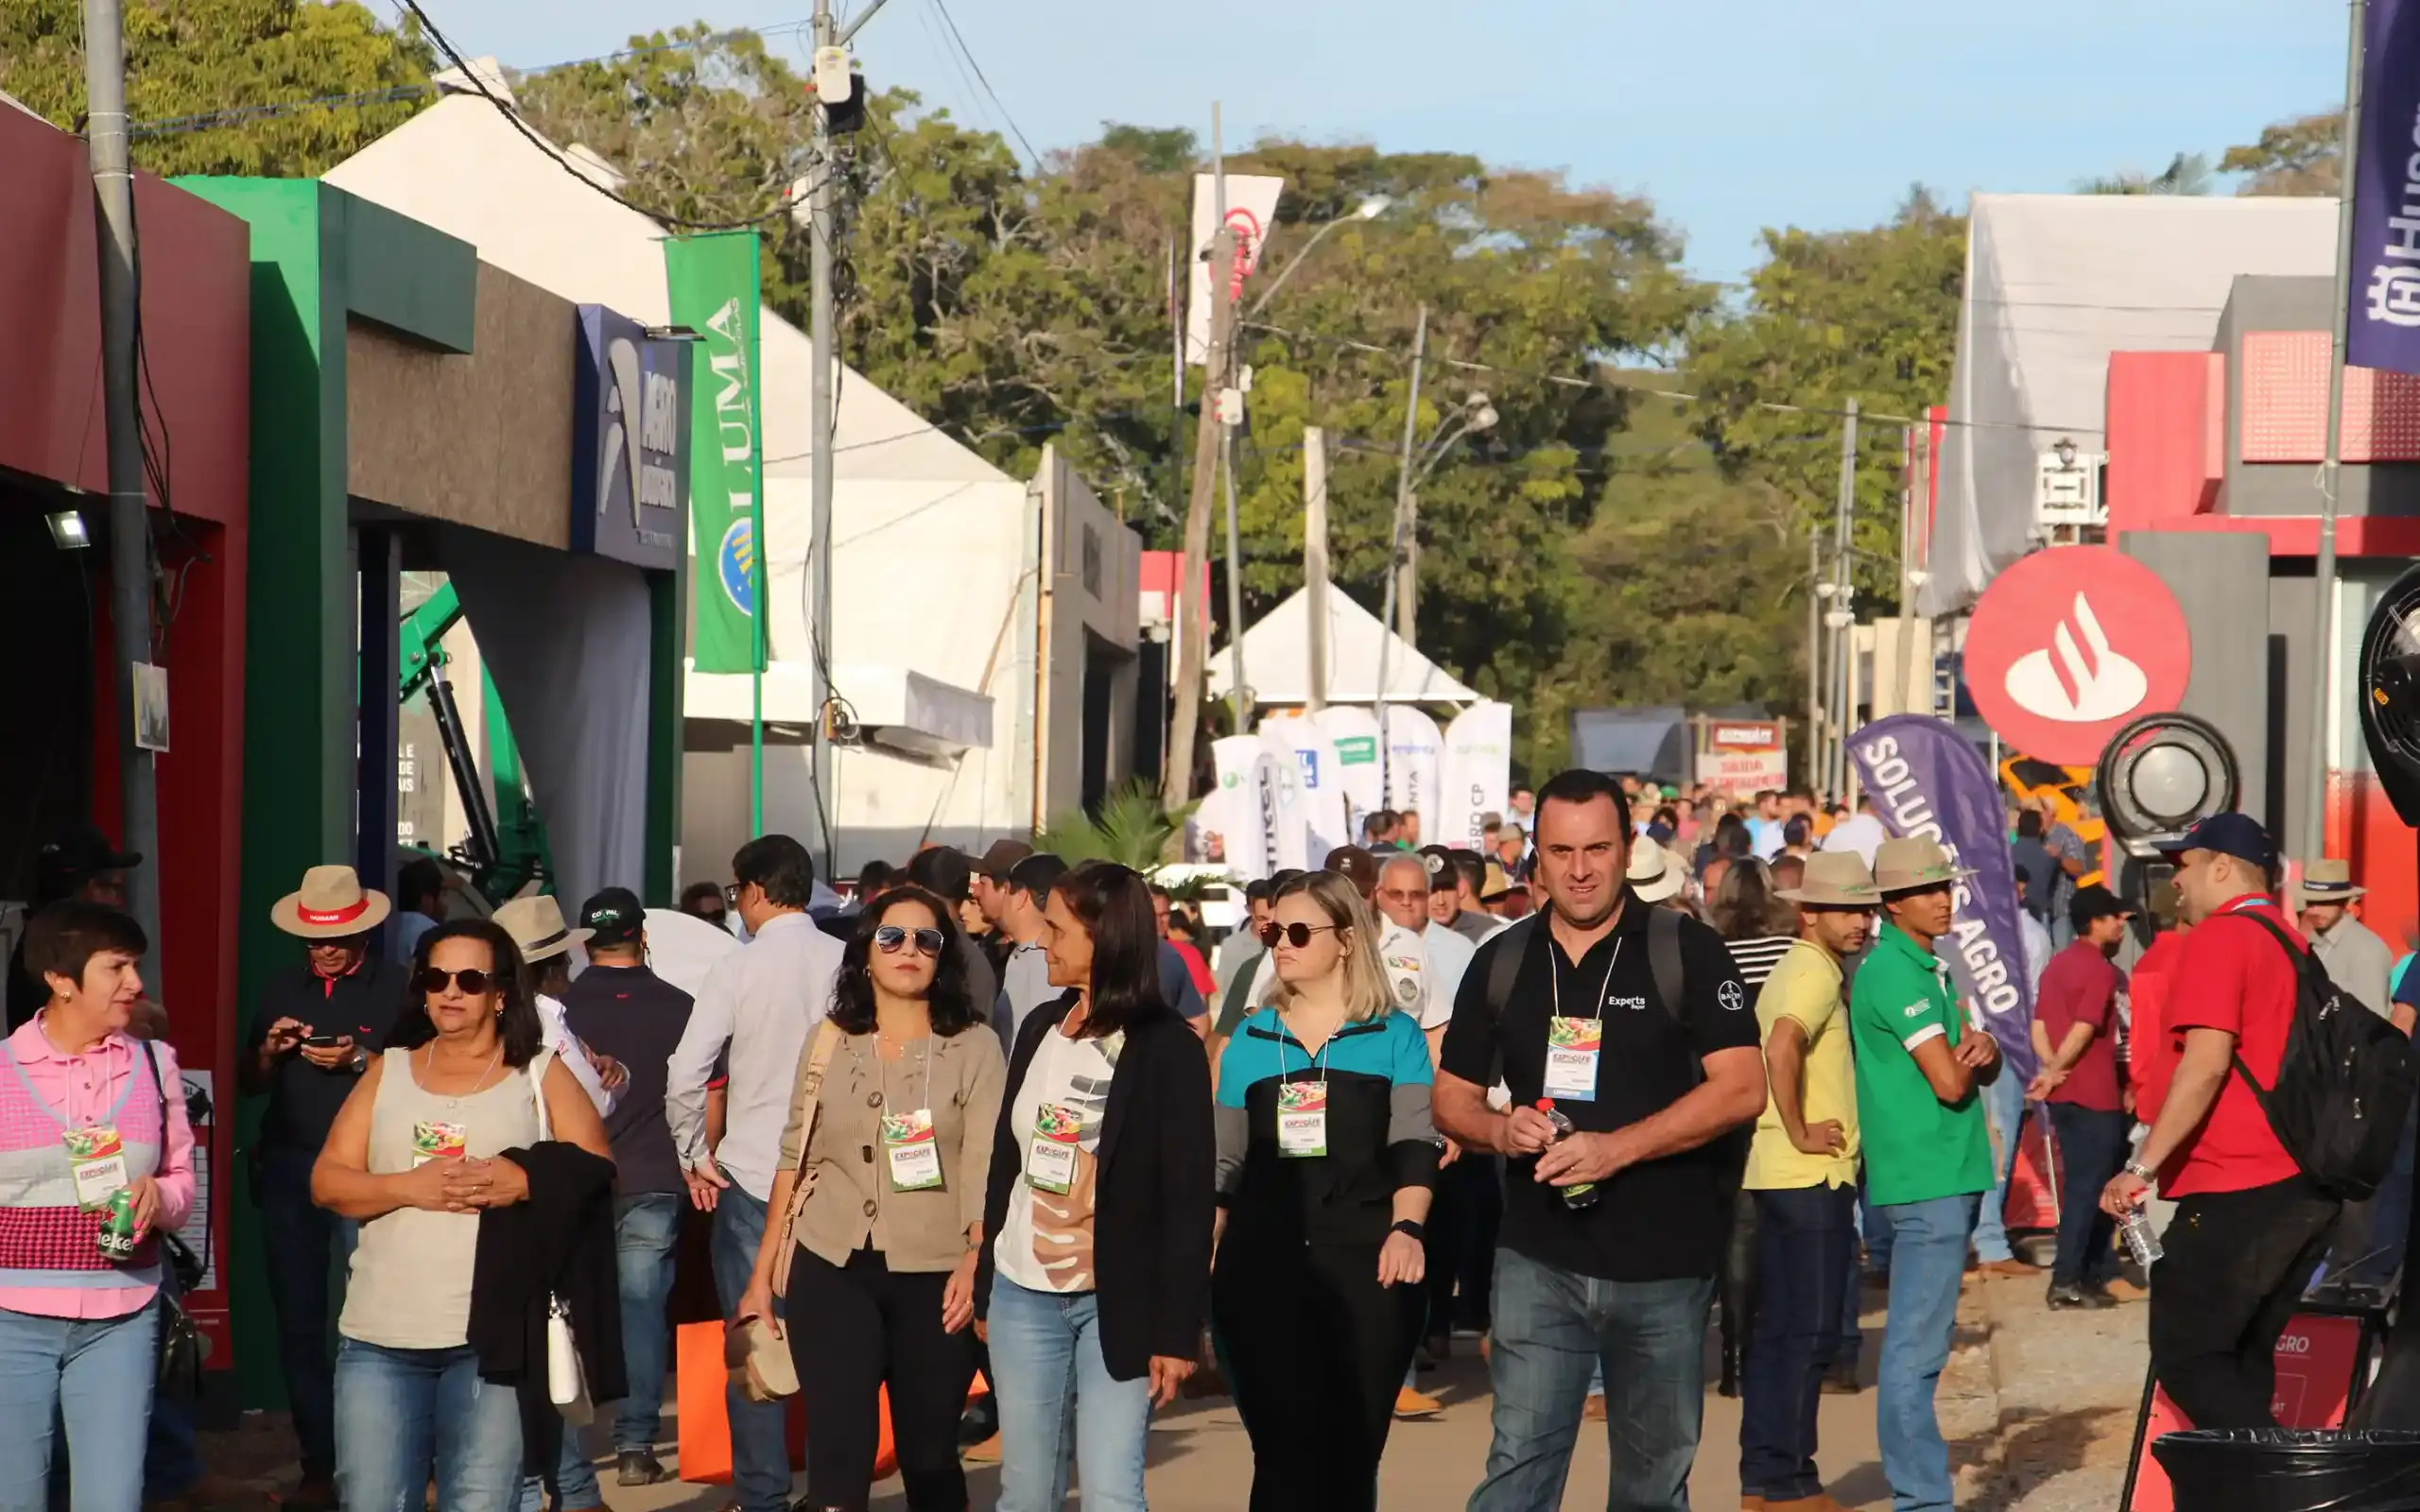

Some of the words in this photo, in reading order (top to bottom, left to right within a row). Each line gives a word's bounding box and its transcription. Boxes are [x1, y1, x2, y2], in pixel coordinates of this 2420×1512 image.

[1950, 919, 2020, 1015] AGRO
[1609, 995, 1645, 1007] Experts
[2275, 1334, 2309, 1352] GRO
